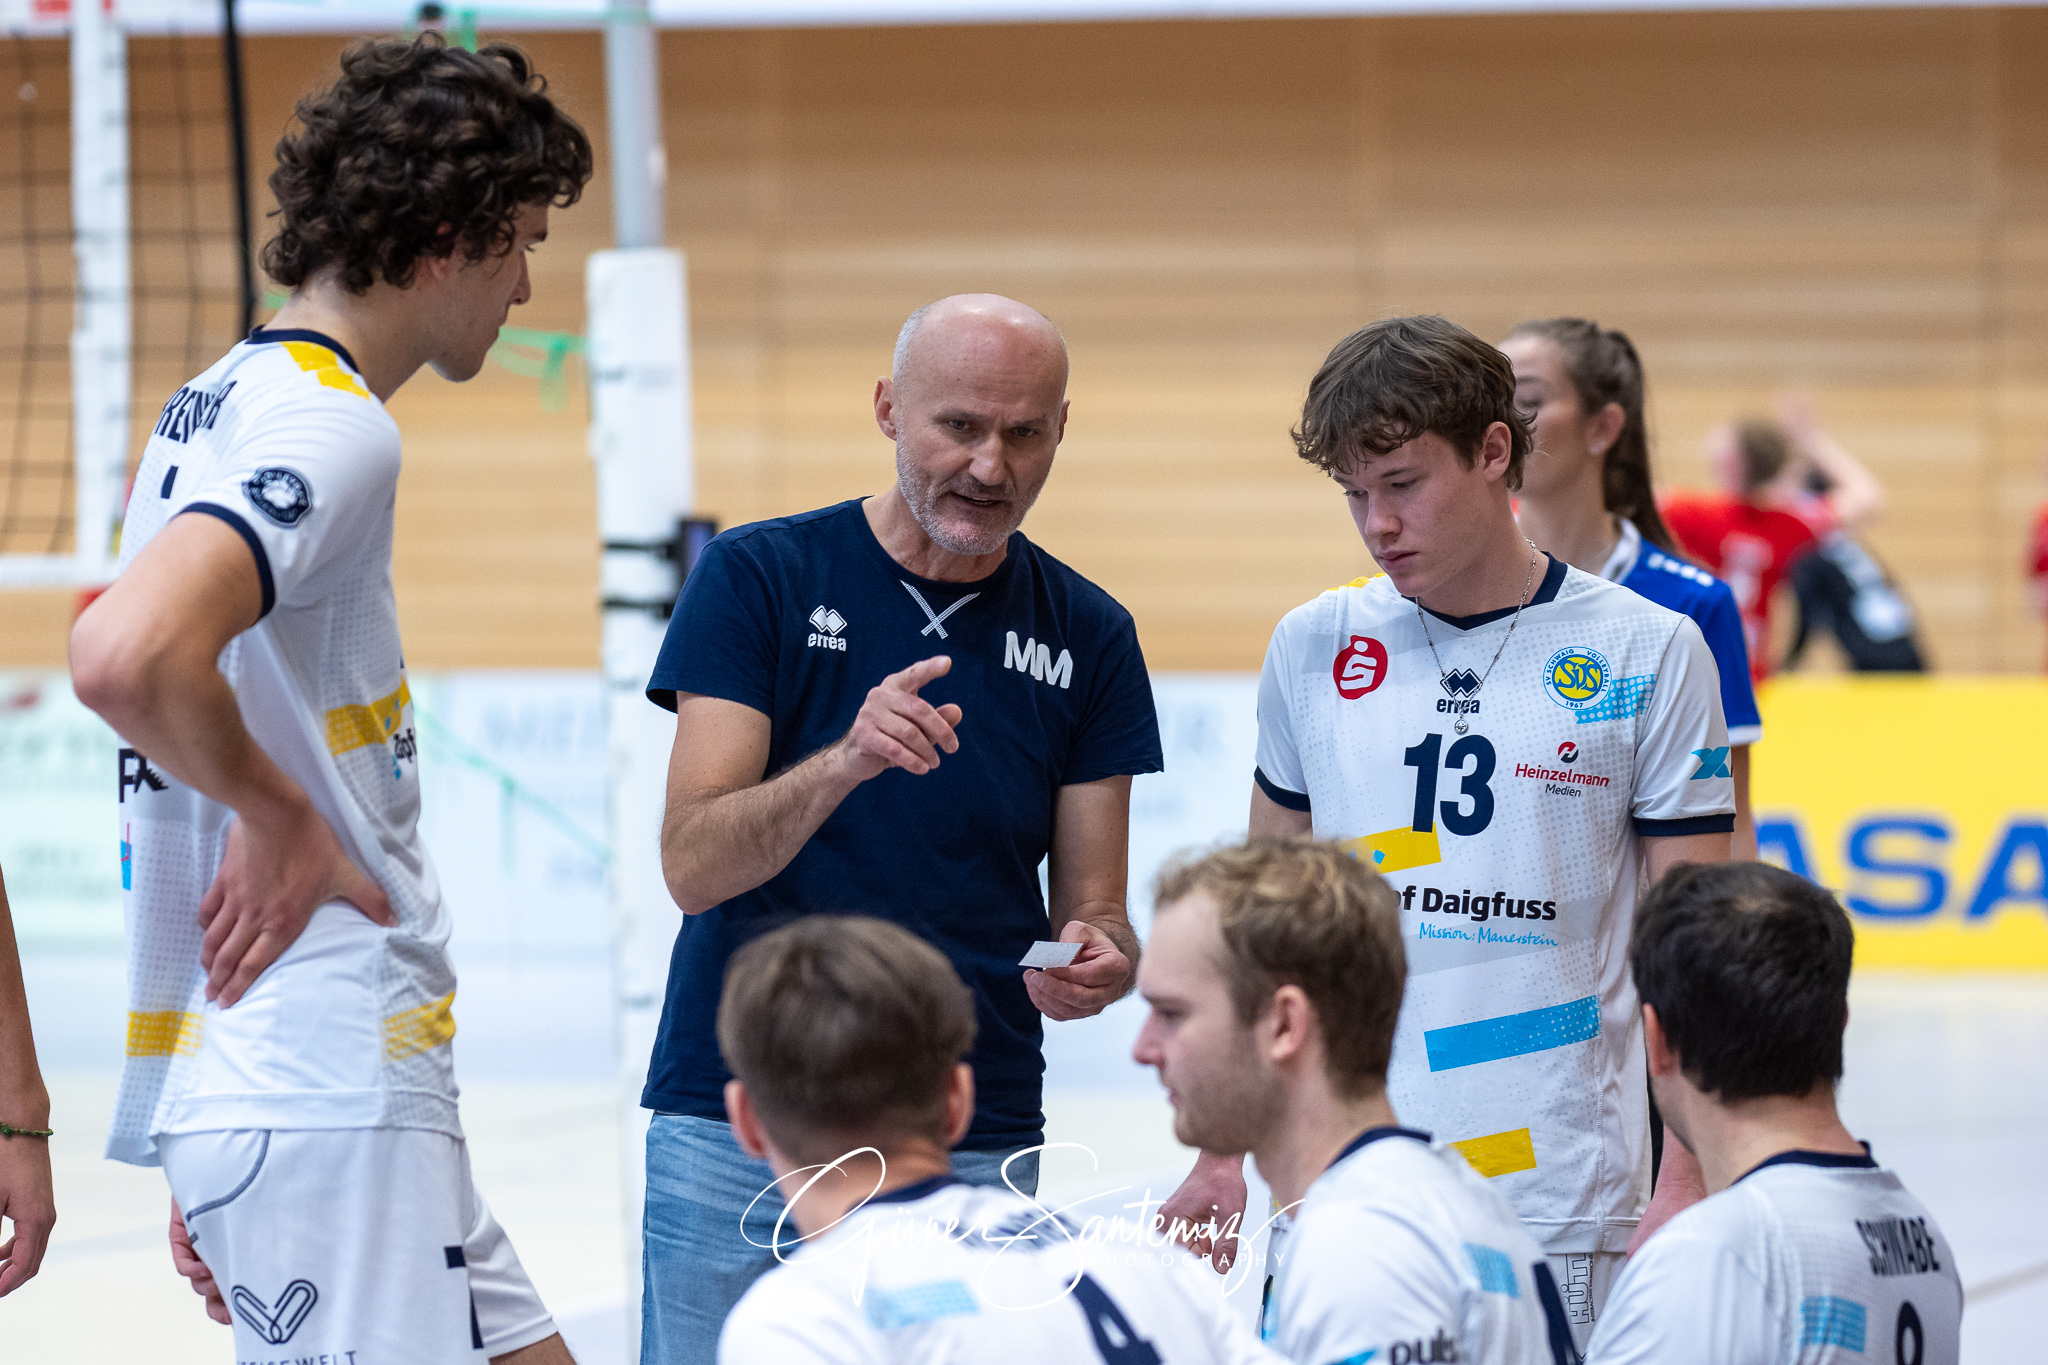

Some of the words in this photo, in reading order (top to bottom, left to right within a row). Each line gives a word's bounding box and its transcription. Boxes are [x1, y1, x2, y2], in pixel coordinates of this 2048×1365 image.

[1004, 631, 1073, 689] MM
[1546, 648, 1574, 673] SCHWAIG
[1587, 650, 1610, 692] VOLLEYBALL
[1565, 700, 1584, 709] 1967
[1404, 732, 1496, 836] 13
[1515, 763, 1610, 788] Heinzelmann
[1545, 783, 1581, 798] Medien
[1421, 887, 1557, 922] Daigfuss
[1419, 922, 1476, 941] Mission:
[1477, 926, 1559, 947] Mauerstein
